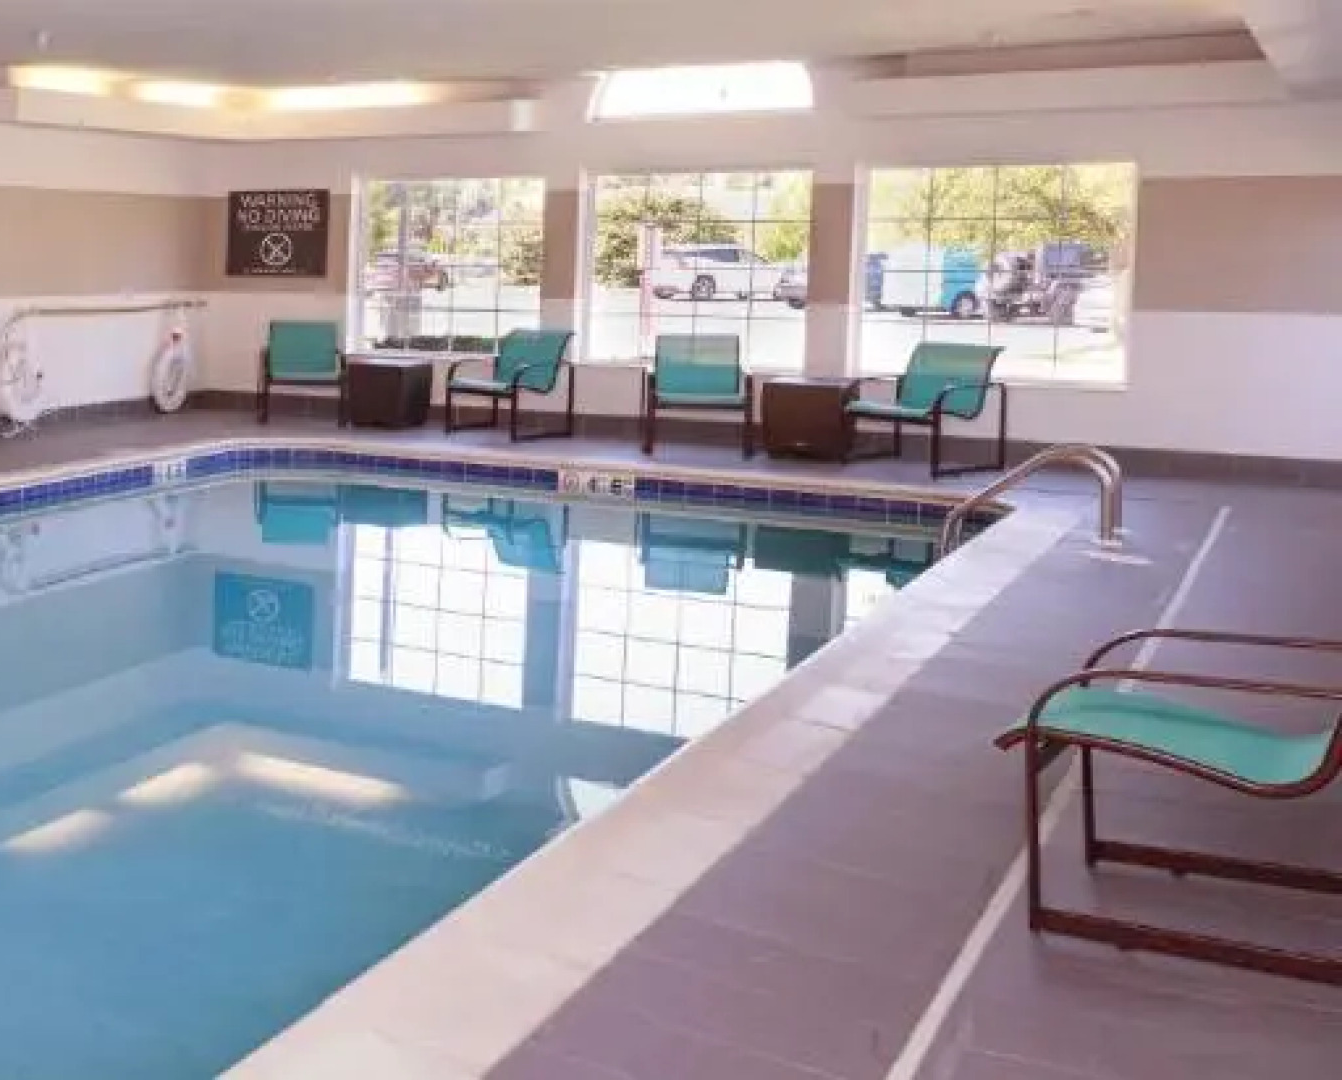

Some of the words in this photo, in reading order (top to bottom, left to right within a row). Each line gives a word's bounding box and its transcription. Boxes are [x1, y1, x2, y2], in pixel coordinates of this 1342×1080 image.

[240, 193, 318, 207] WARNING
[237, 208, 260, 223] NO
[264, 208, 320, 223] DIVING
